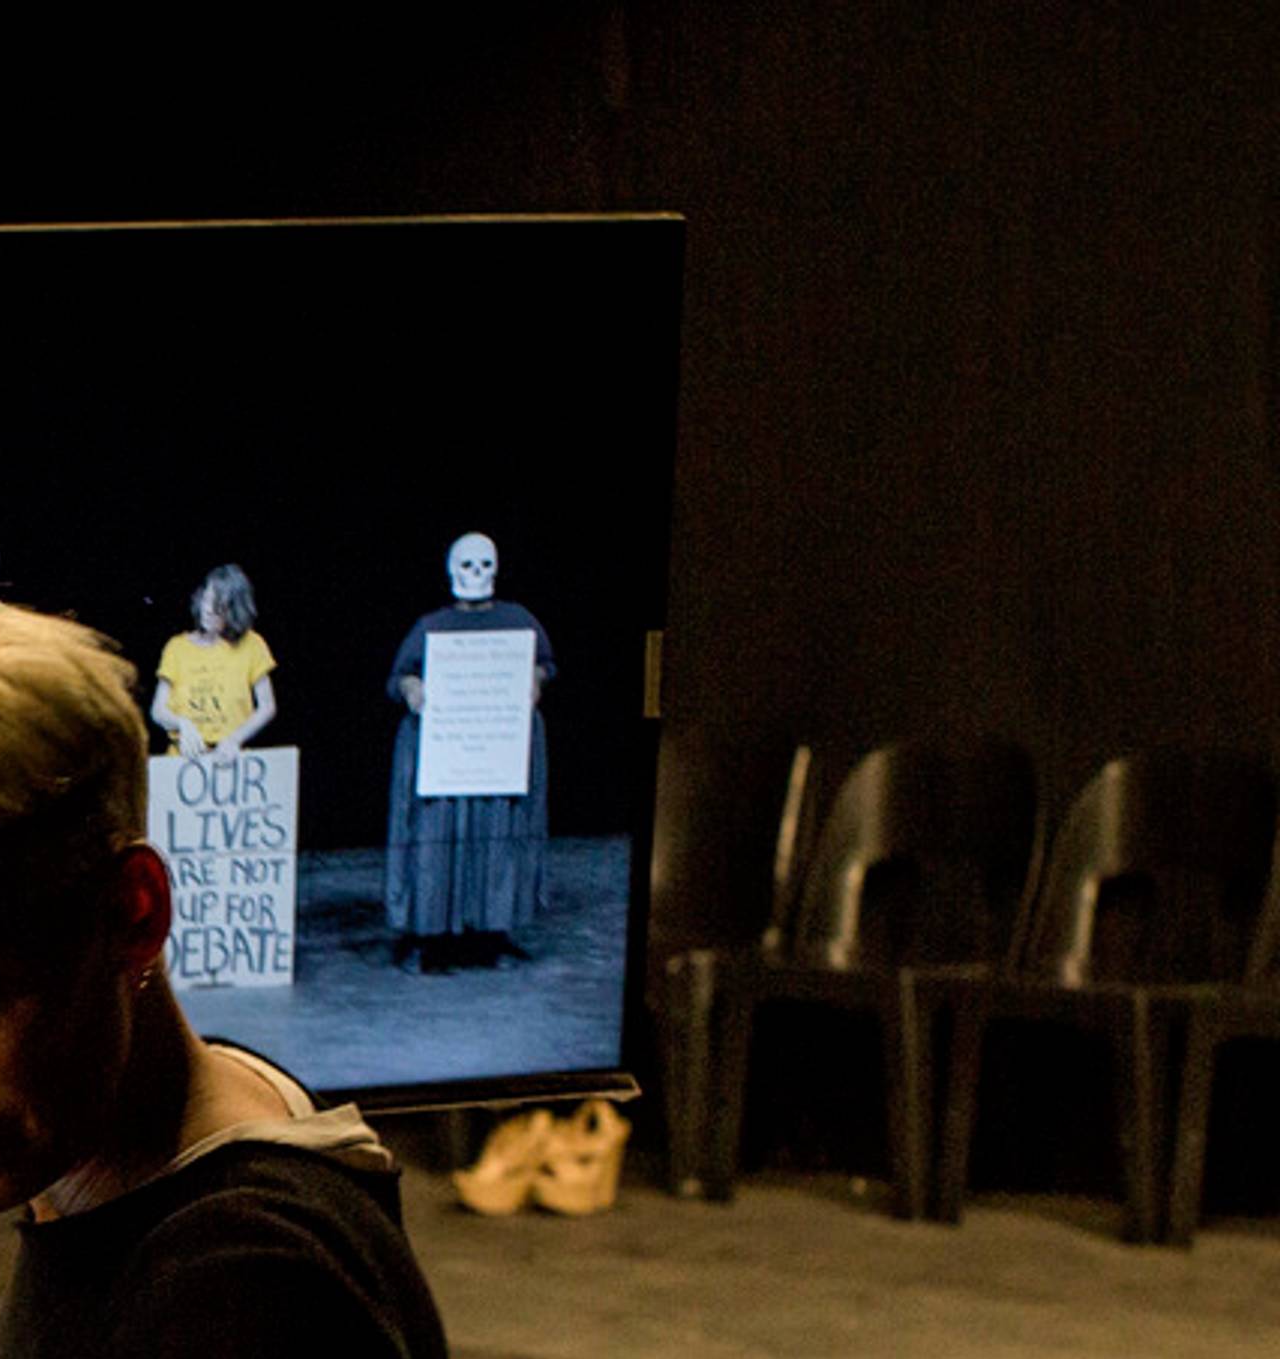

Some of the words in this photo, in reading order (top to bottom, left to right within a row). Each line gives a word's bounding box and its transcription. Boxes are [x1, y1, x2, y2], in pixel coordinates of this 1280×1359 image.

[177, 755, 267, 807] OUR
[168, 804, 287, 853] LIVES
[231, 857, 288, 886] NOT
[179, 891, 218, 924] UP
[226, 894, 276, 926] FOR
